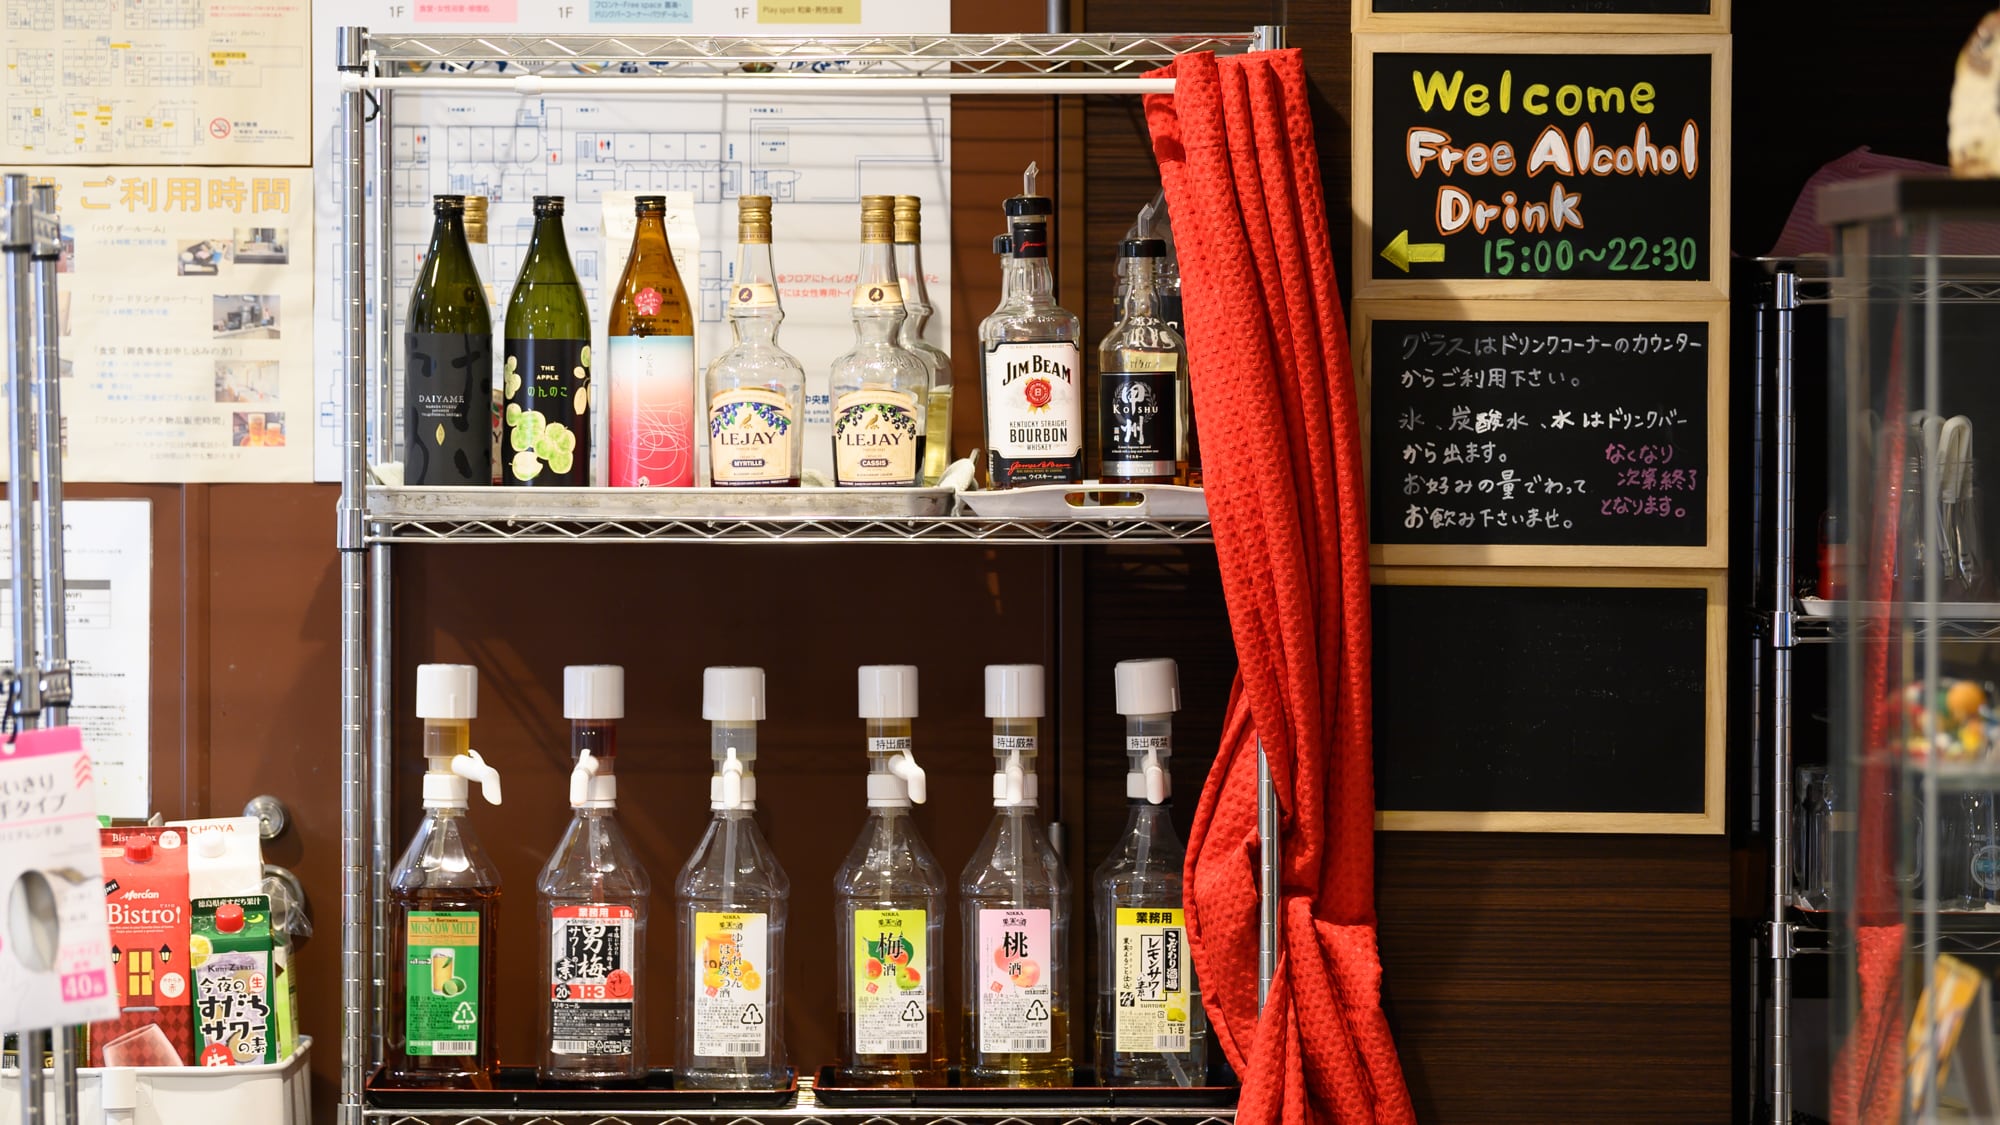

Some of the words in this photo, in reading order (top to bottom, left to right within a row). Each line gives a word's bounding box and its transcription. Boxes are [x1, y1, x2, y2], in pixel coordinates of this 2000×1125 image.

[390, 6, 404, 17] 1F
[558, 7, 573, 18] 1F
[735, 8, 749, 19] 1F
[1413, 70, 1656, 116] Welcome
[1407, 127, 1516, 178] Free
[1527, 118, 1699, 179] Alcohol
[80, 176, 291, 214] ご利用時間
[1435, 181, 1584, 236] Drink
[1002, 361, 1029, 386] JIM
[1032, 354, 1071, 385] BEAM
[1401, 367, 1580, 388] からご利用下さい。
[418, 394, 465, 403] DAIYAME
[527, 386, 569, 398] のんのこ
[721, 432, 776, 446] LEJAY
[847, 433, 902, 446] LEJAY
[1010, 428, 1068, 442] BOURBON
[1403, 441, 1507, 464] から出ます。
[1605, 443, 1673, 464] なくなり
[862, 459, 887, 467] CASSIS
[1403, 469, 1586, 500] お好みの量でわって
[1617, 468, 1698, 492] 次第終了
[1600, 496, 1686, 518] となります。
[1404, 504, 1573, 529] お飲み下さいませ。
[107, 903, 175, 925] Bistro
[578, 908, 609, 917] 業務用
[1136, 912, 1172, 924] 業務用
[411, 922, 449, 934] MOSCOW
[452, 922, 476, 935] MULE
[1147, 937, 1162, 998] レモンサワー
[1166, 931, 1178, 990] こだわり酒場
[200, 977, 245, 993] 今夜の
[251, 977, 264, 989] 生
[578, 986, 606, 998] 1:3
[199, 995, 269, 1019] すだち
[202, 1020, 266, 1041] サワー
[1169, 1026, 1184, 1034] 1:5
[239, 1037, 265, 1053] の素
